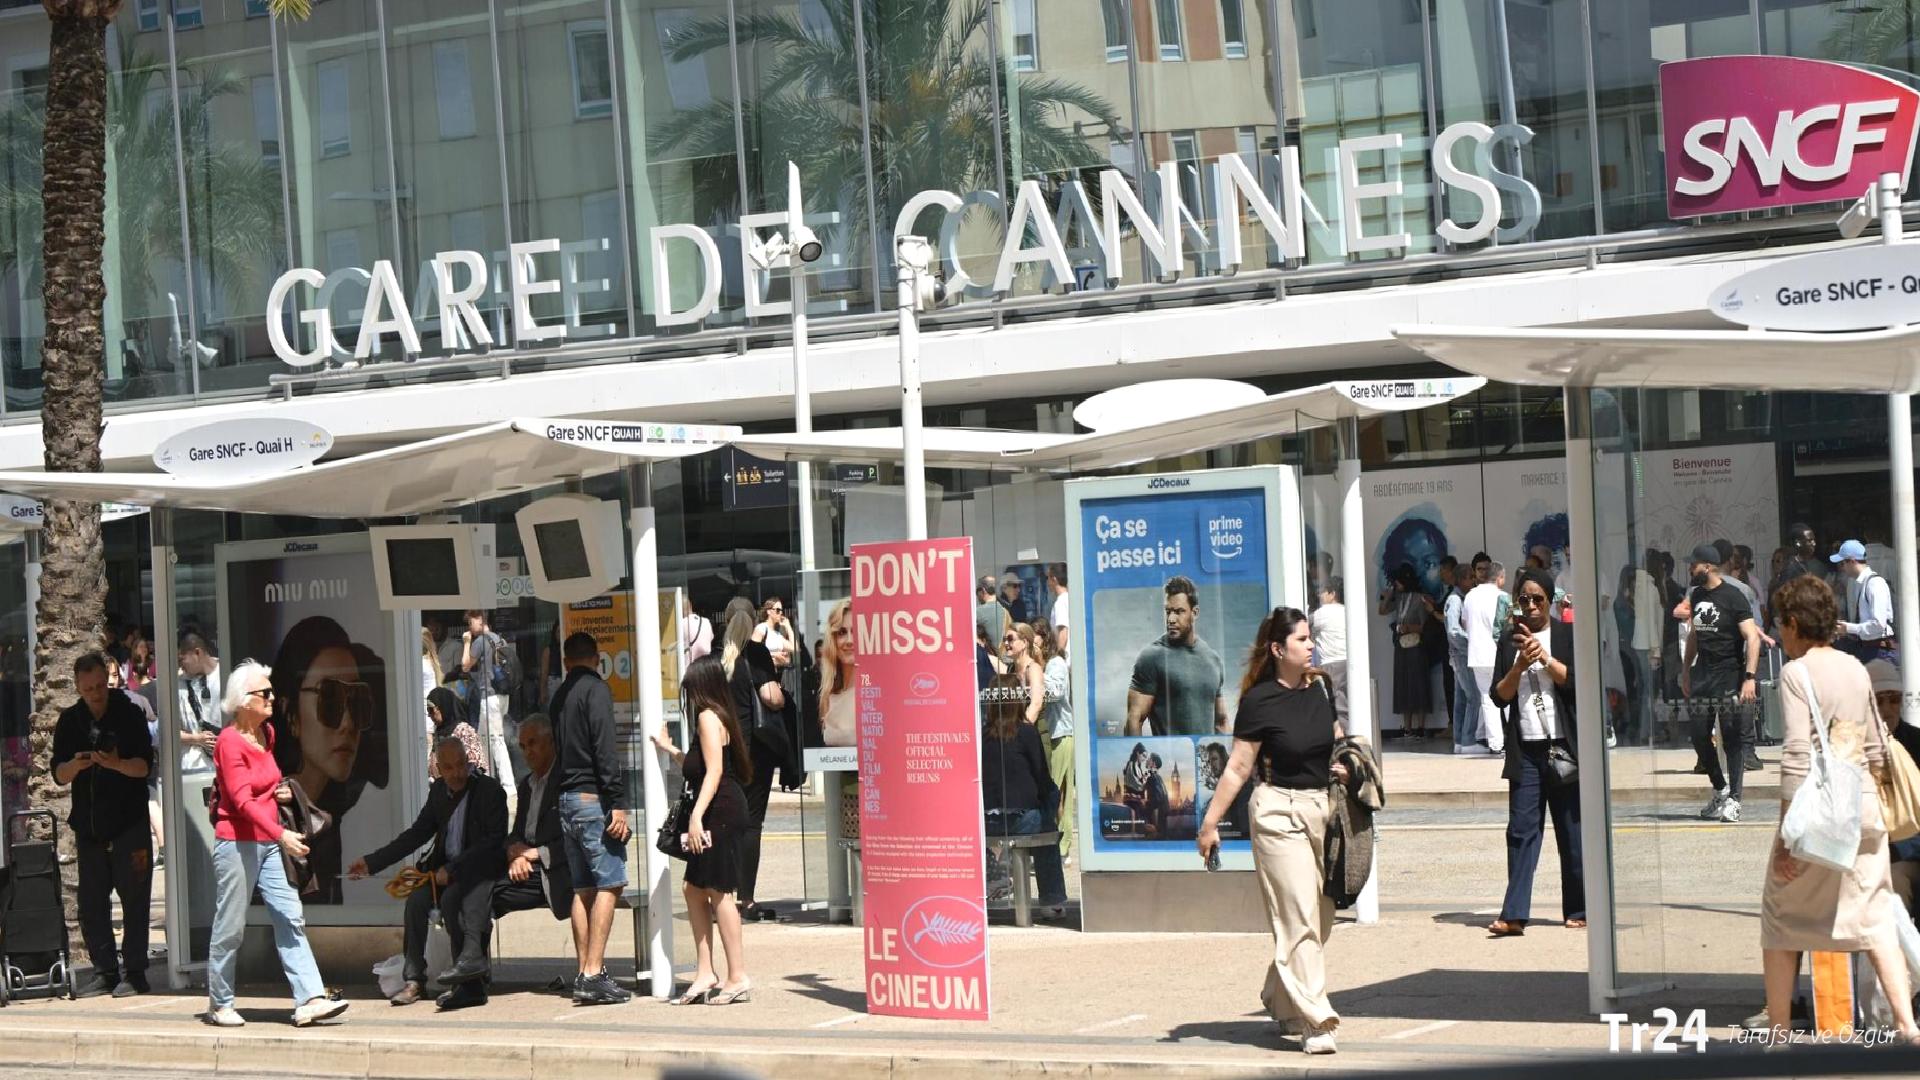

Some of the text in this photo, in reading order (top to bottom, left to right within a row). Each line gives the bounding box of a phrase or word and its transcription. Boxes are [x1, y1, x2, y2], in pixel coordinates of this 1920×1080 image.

[1675, 98, 1899, 196] SNCF
[266, 121, 1502, 367] GARE DE CANNES
[1776, 287, 1822, 307] Gare
[1828, 278, 1882, 302] SNCF
[1901, 275, 1920, 295] Q
[1350, 385, 1369, 398] Gare
[1370, 384, 1394, 398] SNCF
[546, 424, 575, 441] Gare
[577, 425, 610, 441] SNCF
[189, 447, 214, 462] Gare
[217, 442, 246, 460] SNCF
[256, 437, 282, 456] Quai
[284, 437, 293, 452] H
[1672, 458, 1732, 469] Bienvenue
[1147, 478, 1190, 489] JCDecaux
[1437, 480, 1454, 494] ANS
[11, 505, 43, 518] Gare S
[1095, 515, 1147, 544] Ça se
[1208, 515, 1243, 534] prime
[1210, 532, 1243, 547] video
[1097, 540, 1182, 573] passe ici
[855, 548, 964, 597] DON'T
[856, 607, 954, 655] MISS!
[600, 658, 628, 674] 1 2
[861, 687, 881, 698] FESTI
[862, 700, 876, 711] VAL
[862, 712, 883, 724] INTER
[862, 725, 884, 737] NATIO
[863, 738, 877, 750] NAL
[906, 733, 923, 744] THE
[864, 750, 874, 761] DU
[906, 745, 945, 758] OFFICIAL
[820, 754, 848, 764] MÉLANIE
[906, 759, 953, 770] SELECTION
[864, 763, 881, 776] FILM
[865, 776, 875, 787] DE
[906, 773, 941, 784] RERUNS
[865, 788, 880, 800] CAN
[865, 801, 880, 812] NES
[869, 927, 899, 961] LE
[870, 972, 981, 1010] CINEUM
